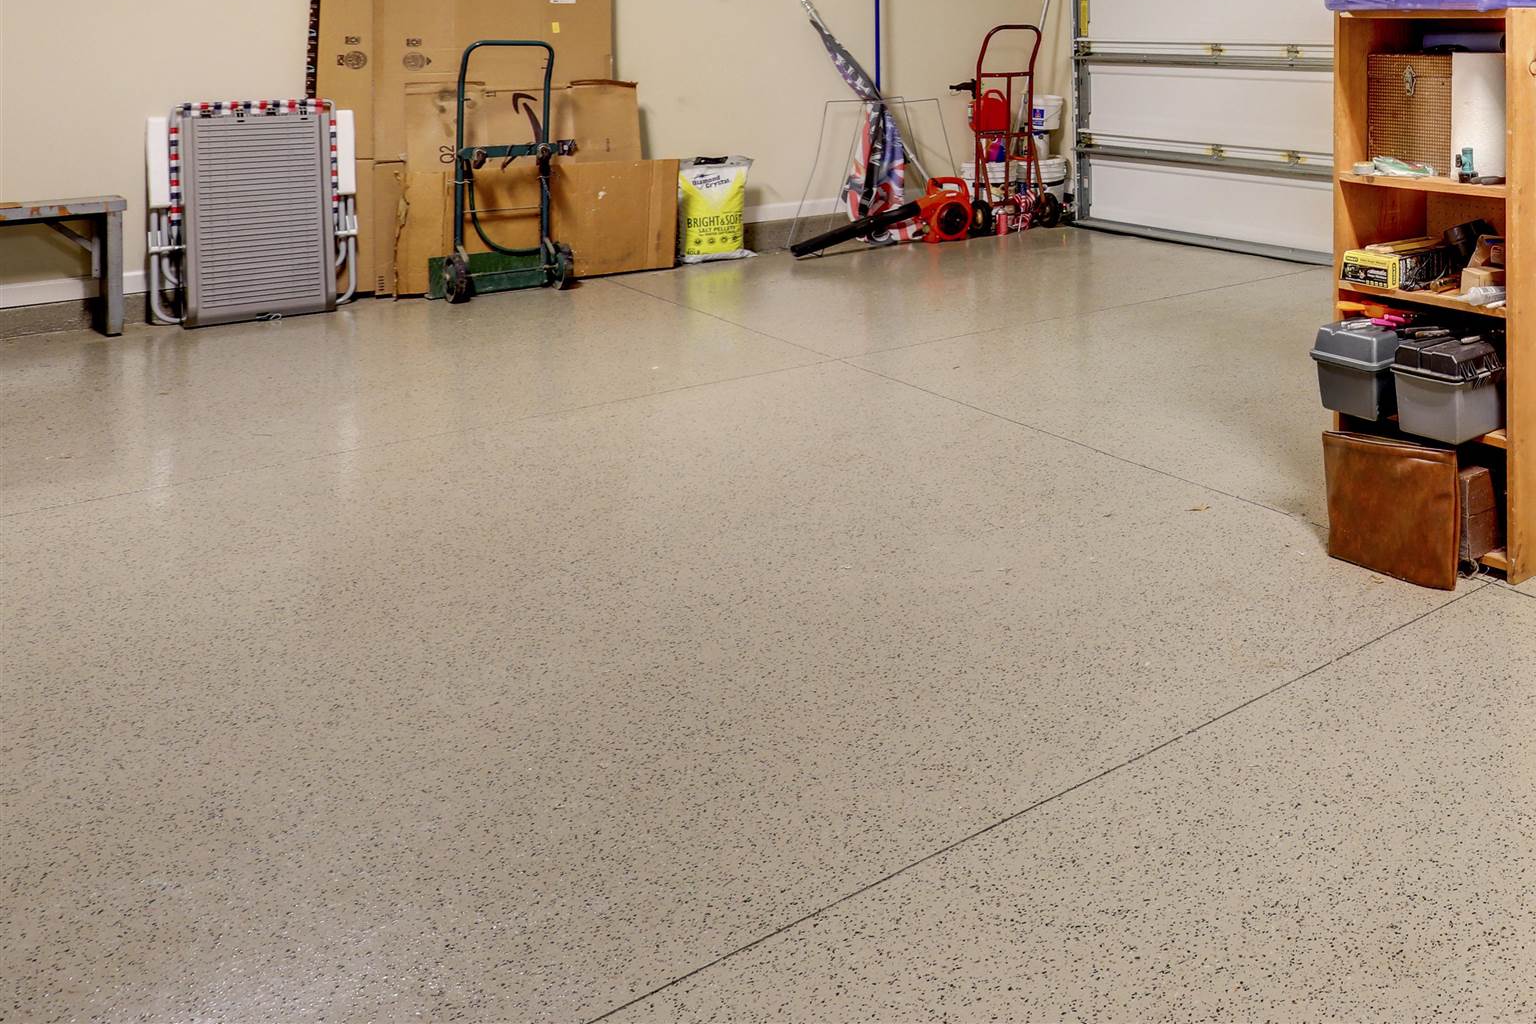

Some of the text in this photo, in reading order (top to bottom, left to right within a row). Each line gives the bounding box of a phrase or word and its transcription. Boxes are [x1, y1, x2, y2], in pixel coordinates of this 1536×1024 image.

[439, 145, 456, 163] Q2
[705, 178, 730, 189] Crystal
[686, 216, 720, 229] BRIGHT
[725, 214, 742, 226] SOFT
